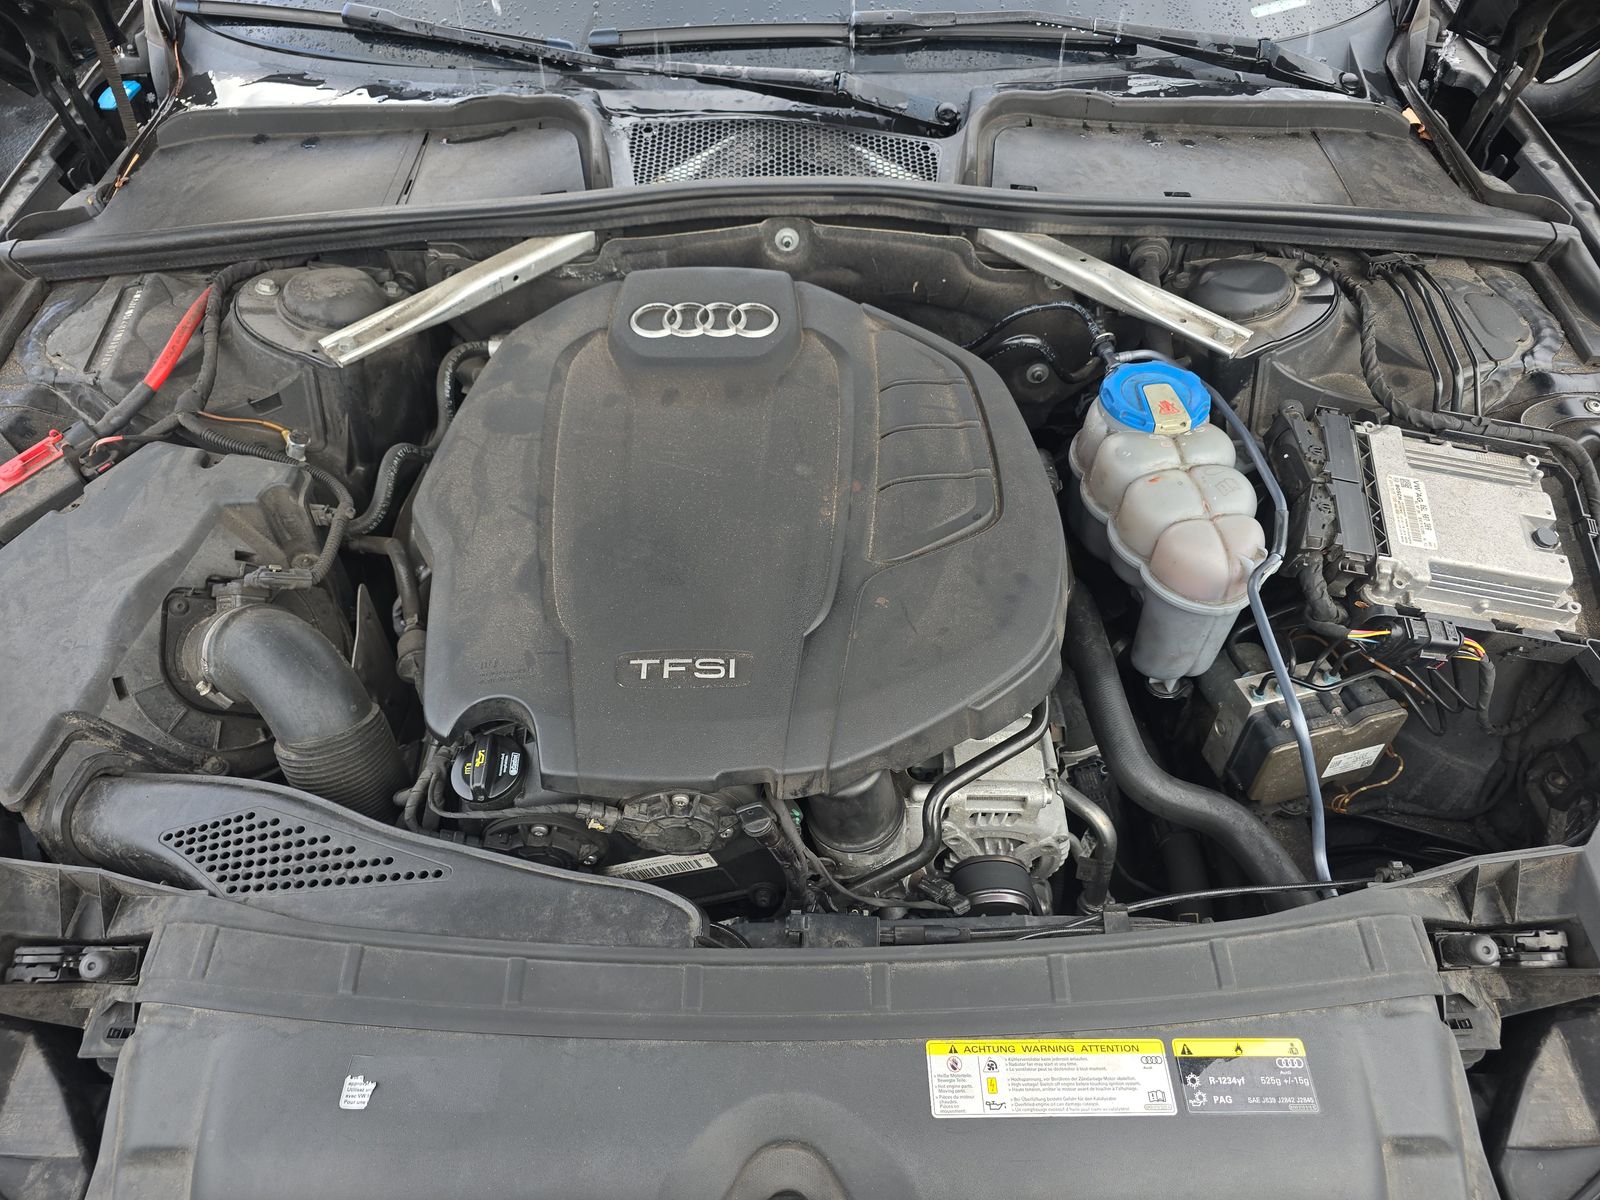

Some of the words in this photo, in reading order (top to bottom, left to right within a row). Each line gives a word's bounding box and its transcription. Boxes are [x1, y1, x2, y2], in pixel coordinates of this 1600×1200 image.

[630, 658, 736, 680] TFSI
[964, 1044, 1016, 1053] ACHTUNG
[1021, 1044, 1075, 1053] WARNING
[1080, 1044, 1140, 1053] ATTENTION
[1208, 1076, 1245, 1086] R-1234yf
[1260, 1076, 1281, 1086] 525g
[1213, 1096, 1232, 1104] PAG
